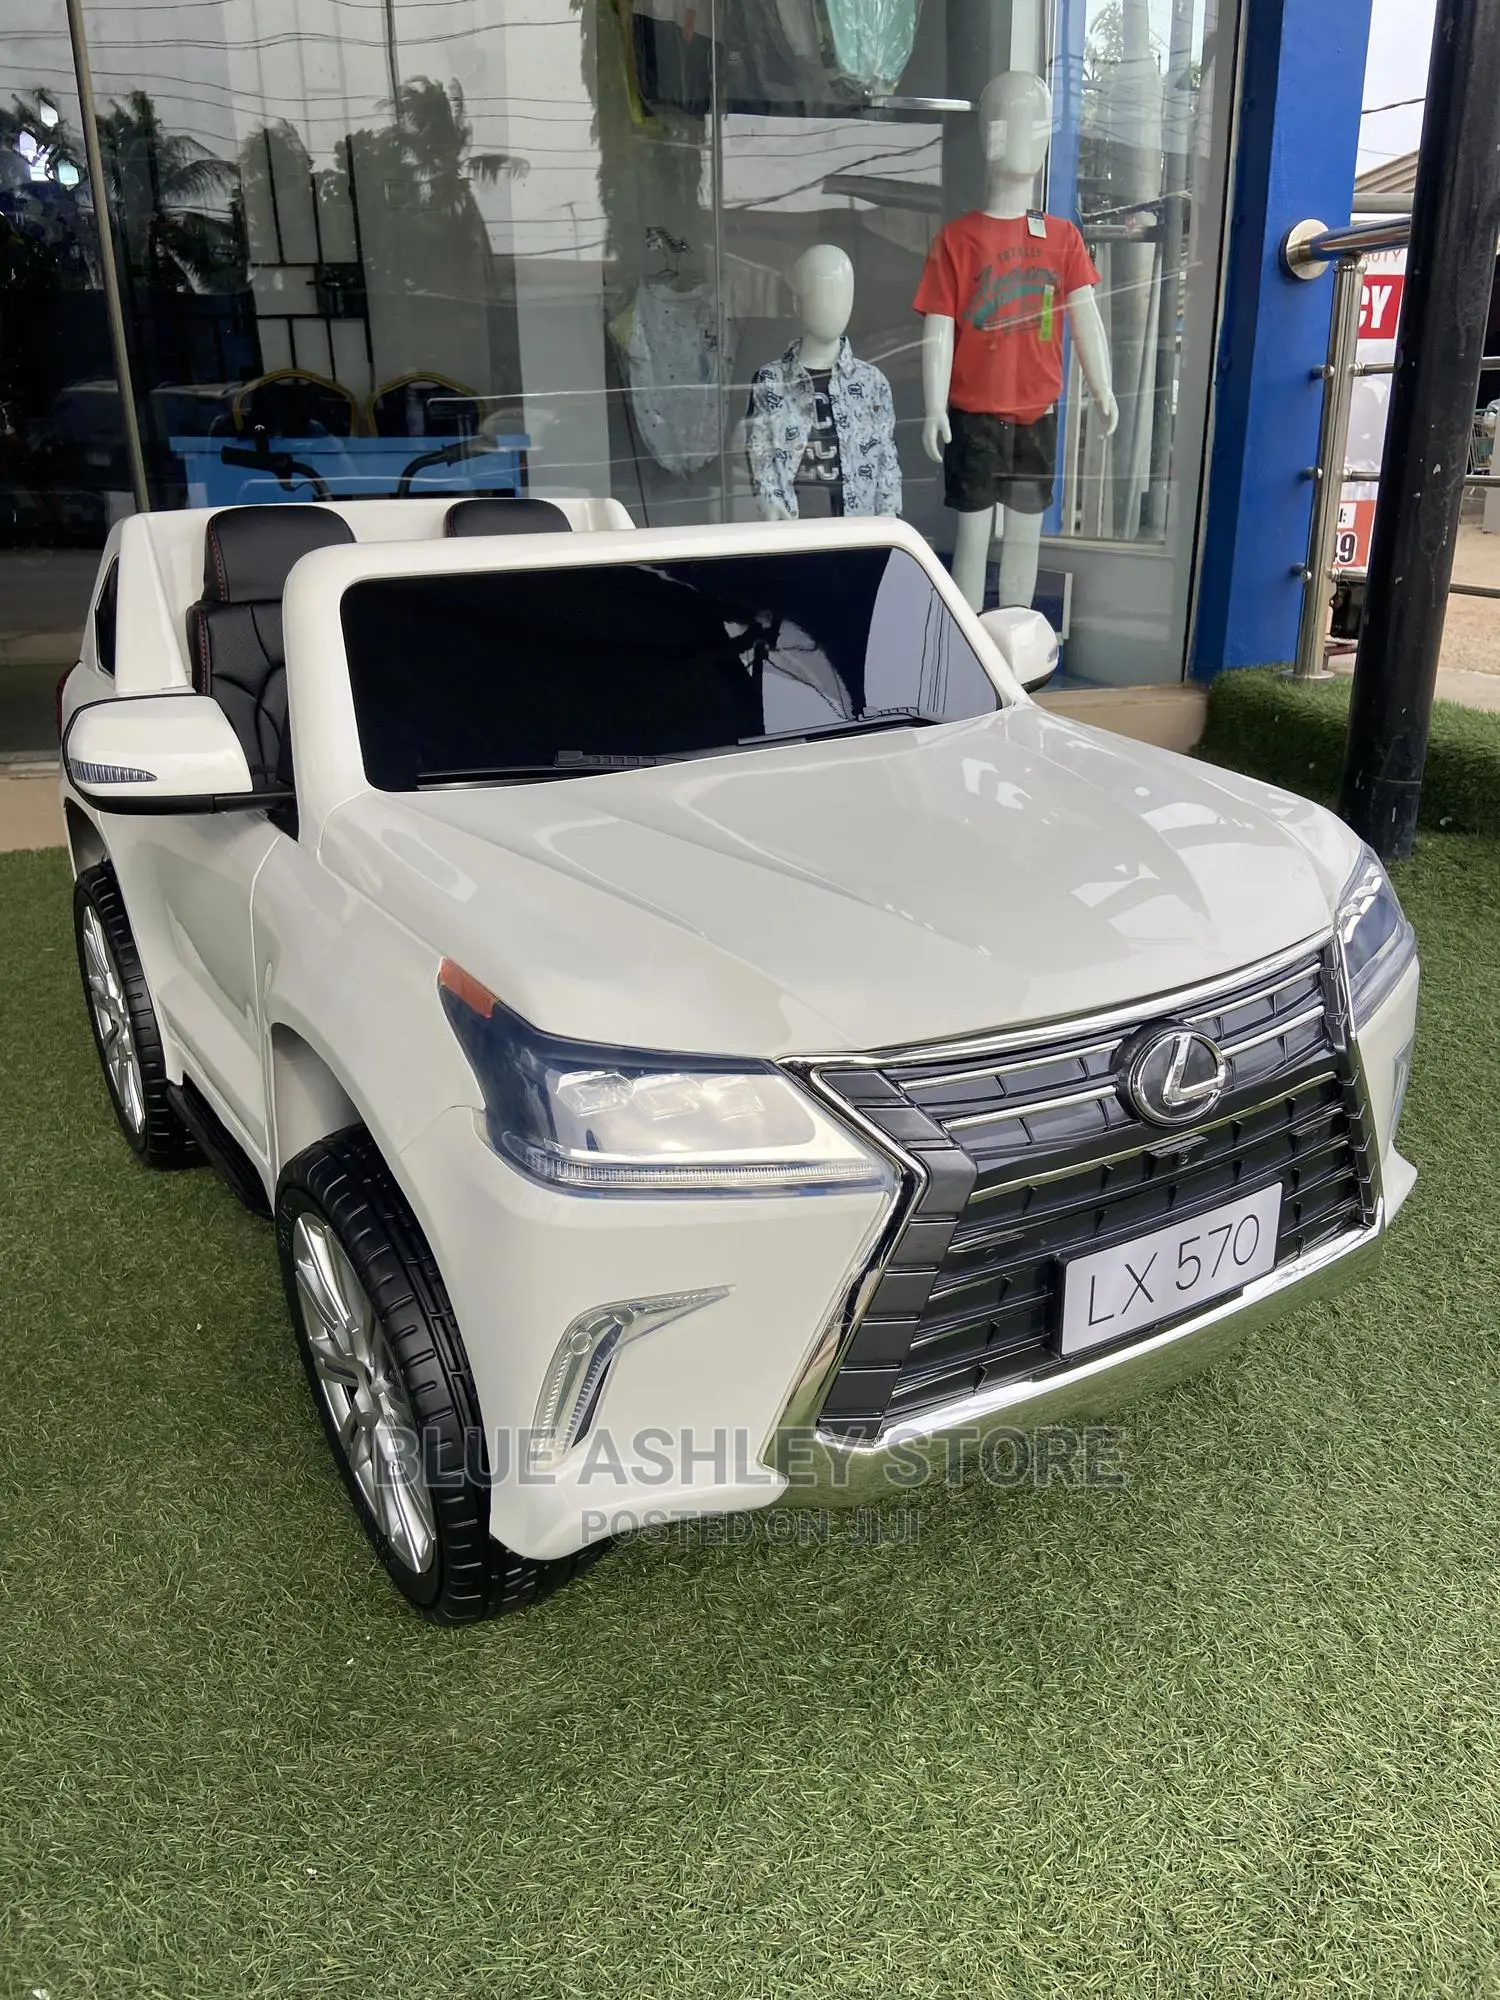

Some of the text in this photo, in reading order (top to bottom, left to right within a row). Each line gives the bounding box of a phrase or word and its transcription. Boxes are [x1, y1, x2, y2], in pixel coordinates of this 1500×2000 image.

[1335, 534, 1355, 562] 9
[1088, 1213, 1260, 1326] LX 570
